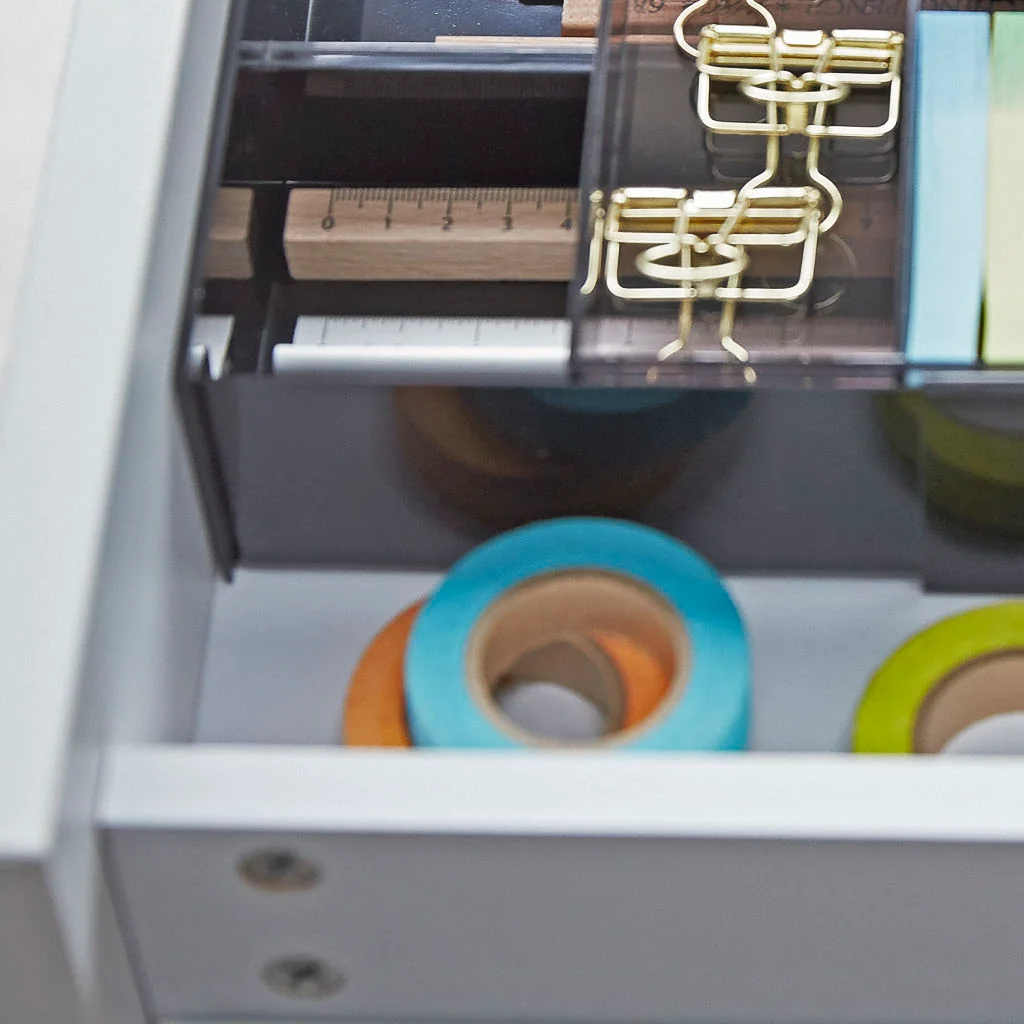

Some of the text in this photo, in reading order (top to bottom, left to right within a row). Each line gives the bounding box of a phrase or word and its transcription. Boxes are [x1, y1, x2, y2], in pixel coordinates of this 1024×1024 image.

[321, 215, 336, 230] 0
[442, 216, 455, 231] 2
[503, 215, 514, 231] 3
[560, 217, 572, 230] 4
